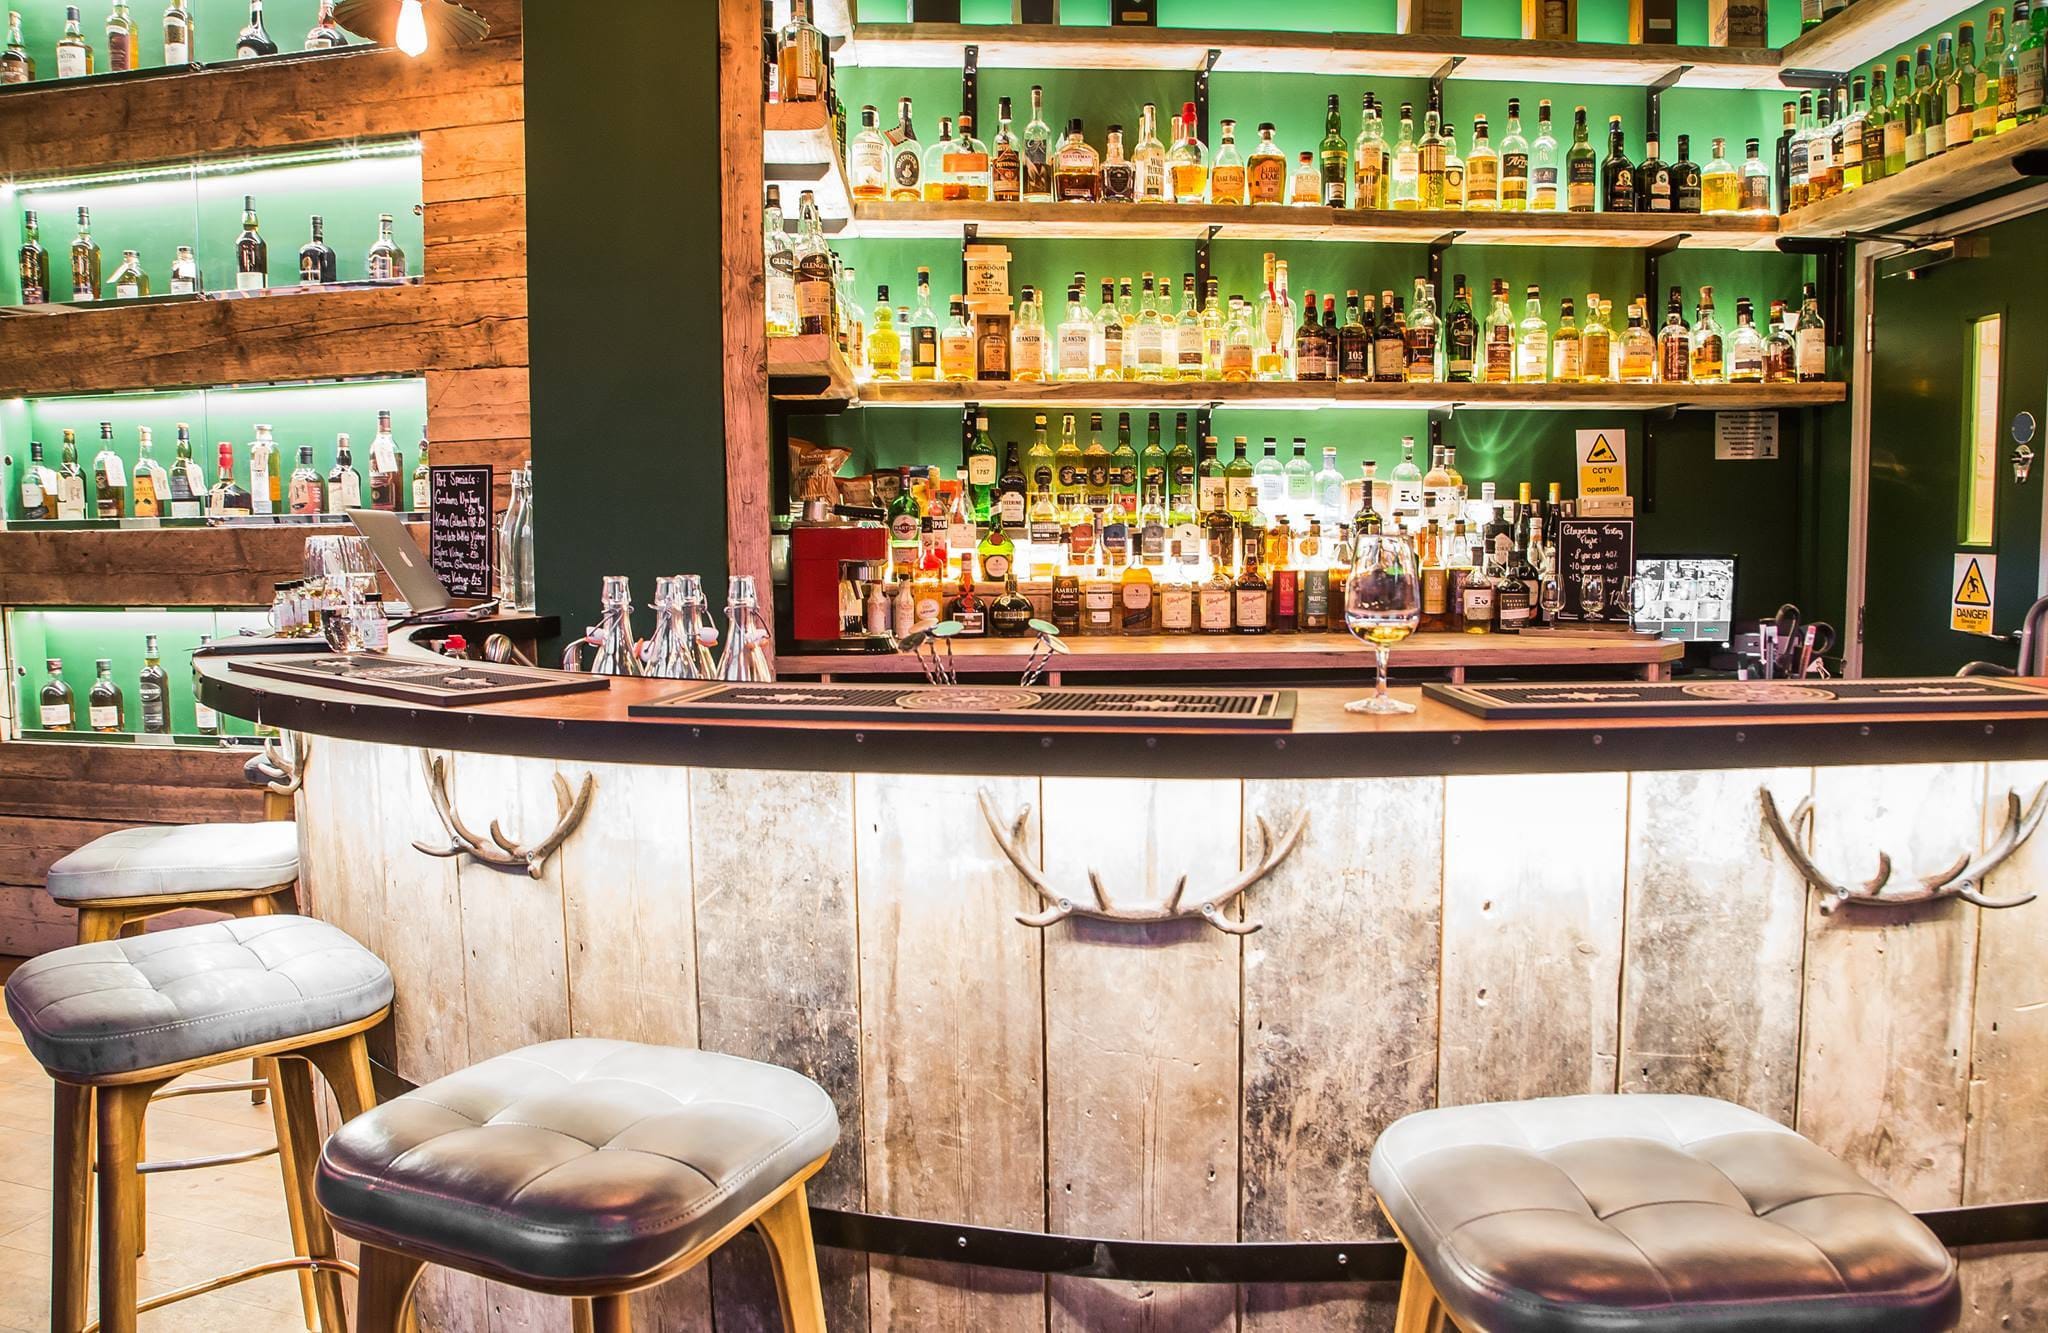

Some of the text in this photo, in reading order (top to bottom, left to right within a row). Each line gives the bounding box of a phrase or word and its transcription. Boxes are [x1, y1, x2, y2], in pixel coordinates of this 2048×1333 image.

[1147, 176, 1160, 185] RYE
[1347, 351, 1364, 360] 105
[1957, 607, 1988, 620] DANGER
